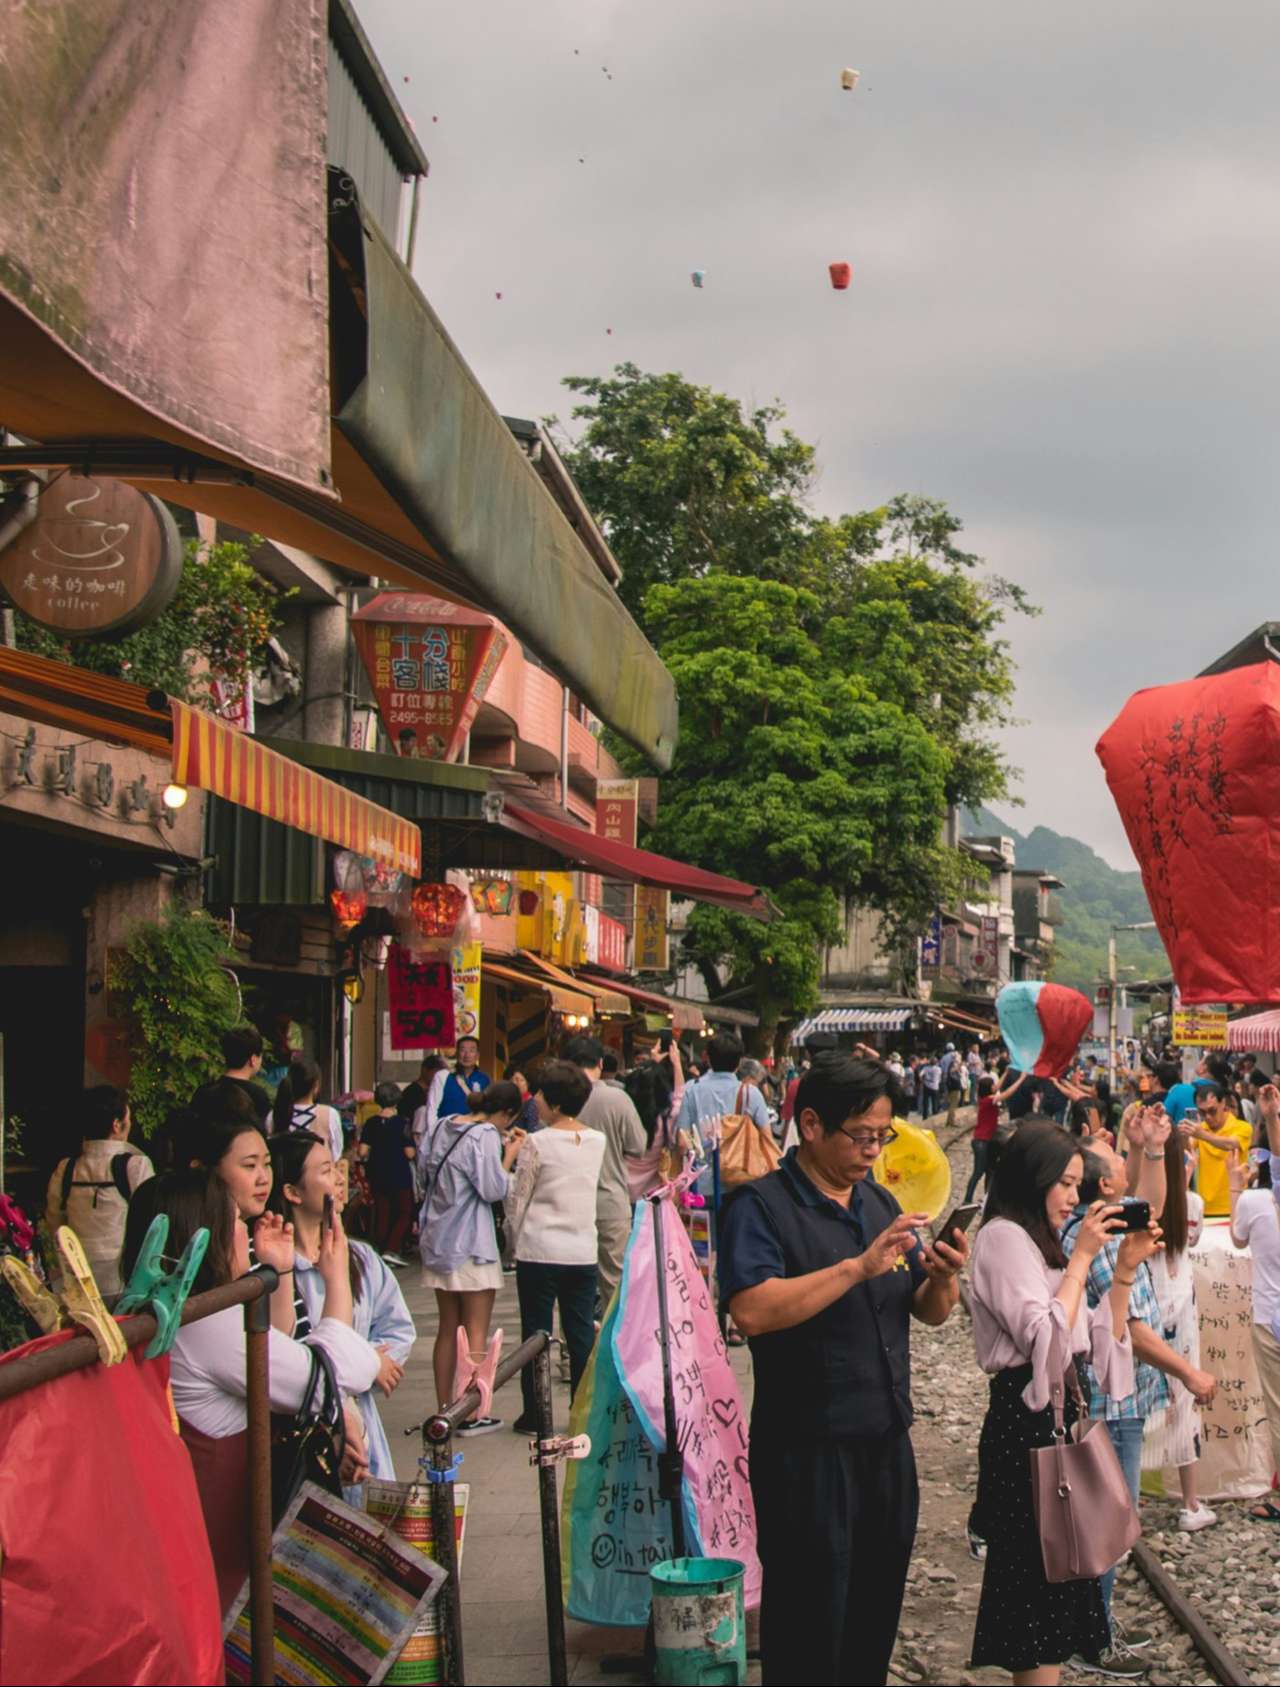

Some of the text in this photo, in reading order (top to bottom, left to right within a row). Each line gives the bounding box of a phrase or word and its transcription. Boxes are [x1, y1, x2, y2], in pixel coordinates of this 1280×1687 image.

[47, 596, 101, 611] coffee
[392, 624, 449, 661] 十分
[392, 659, 449, 692] 客棧
[397, 1008, 444, 1038] 50
